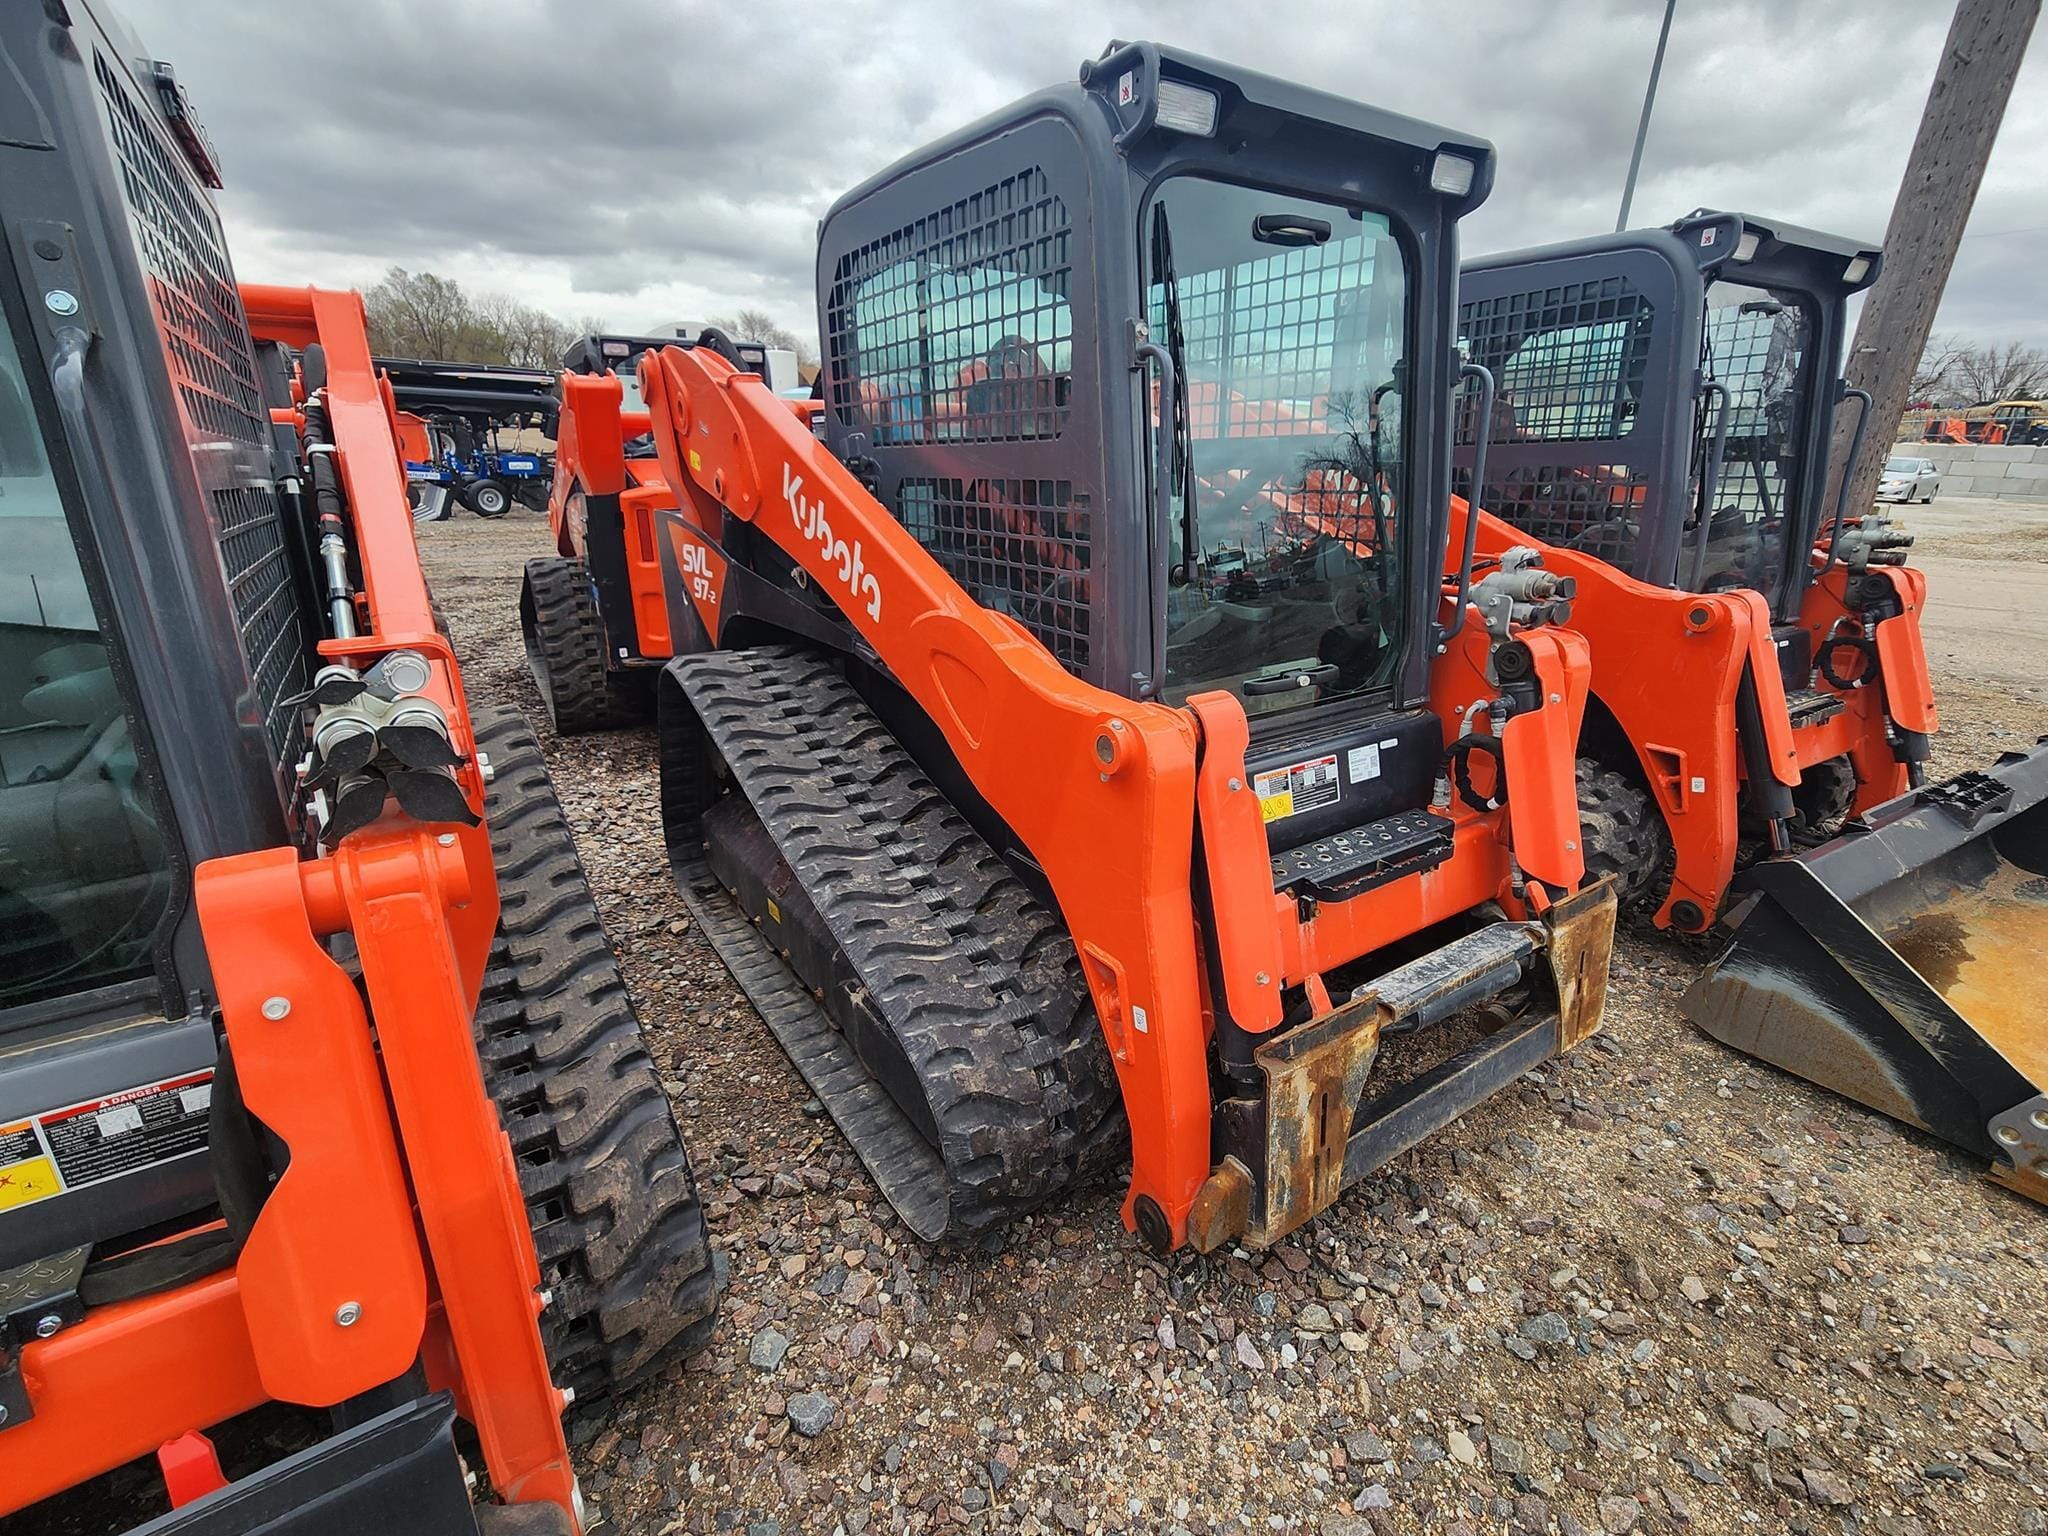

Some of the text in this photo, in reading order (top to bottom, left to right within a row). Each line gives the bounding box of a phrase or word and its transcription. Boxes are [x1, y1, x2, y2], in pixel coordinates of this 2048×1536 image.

[783, 461, 881, 624] Kubota
[682, 544, 713, 578] SVL
[694, 577, 716, 604] 97-2
[67, 1115, 77, 1123] TO
[78, 1110, 98, 1121] AVOID
[99, 1101, 134, 1114] PERSONAL
[135, 1094, 159, 1104] INJURY
[159, 1090, 169, 1098] OR
[111, 1086, 161, 1105] DANGER
